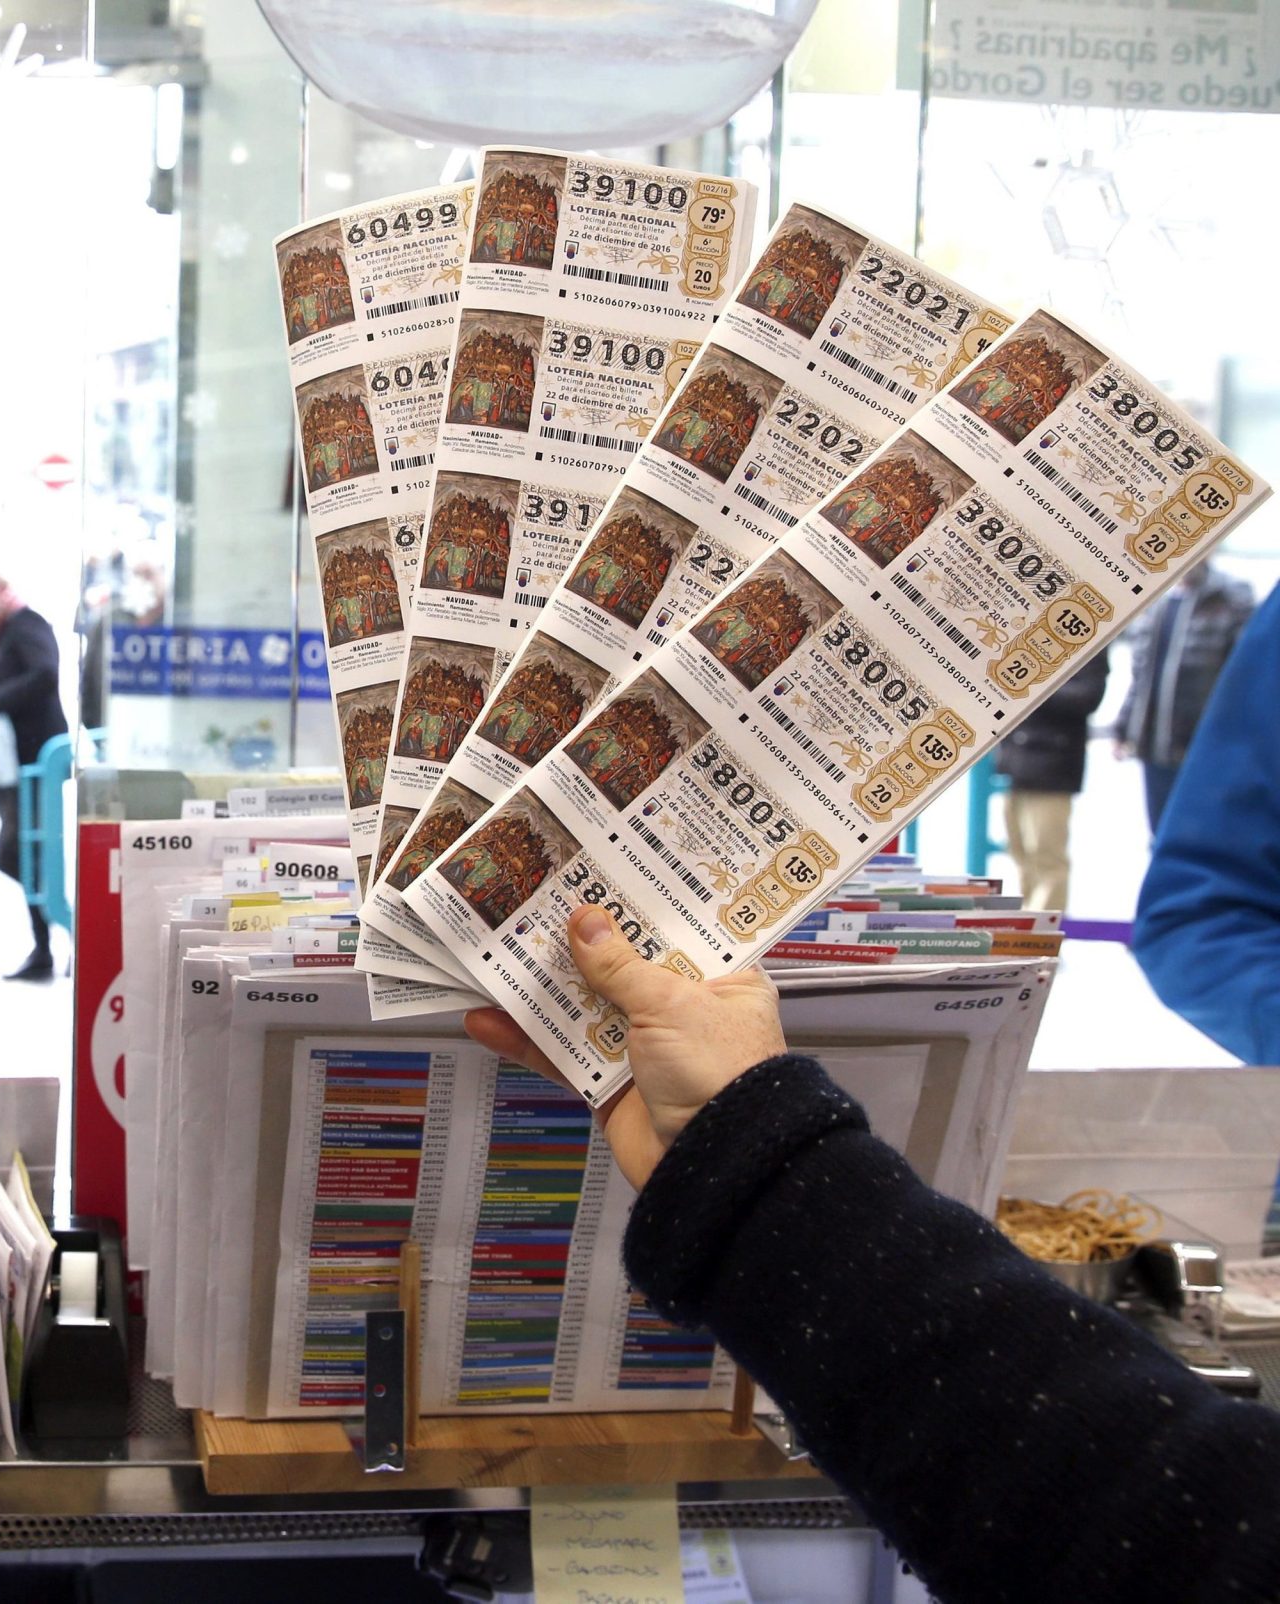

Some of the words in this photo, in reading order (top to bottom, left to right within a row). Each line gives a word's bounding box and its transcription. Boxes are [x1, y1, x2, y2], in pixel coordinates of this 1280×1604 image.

[572, 173, 686, 208] 39100
[348, 203, 456, 243] 60499
[620, 213, 676, 228] NACIONAL
[403, 234, 457, 249] NACIONAL
[569, 229, 579, 237] 22
[581, 232, 592, 240] de
[594, 234, 635, 247] diciembre
[637, 241, 648, 249] de
[650, 243, 670, 253] 2016
[361, 275, 370, 284] 22
[372, 273, 383, 281] de
[385, 265, 424, 277] diciembre
[439, 257, 459, 267] 2016
[694, 269, 711, 283] 20
[860, 258, 968, 329] 22021
[840, 309, 851, 319] 22
[851, 317, 862, 326] de
[863, 324, 900, 349] diciembre
[901, 347, 912, 356] de
[913, 352, 933, 367] 2016
[896, 313, 946, 346] NACIONAL
[987, 316, 1008, 331] 102/1
[549, 331, 664, 369] 39100
[371, 358, 449, 391] 604
[598, 374, 653, 389] NACIONAL
[546, 390, 556, 399] 22
[558, 393, 569, 401] de
[571, 395, 613, 409] diciembre
[615, 403, 626, 411] de
[628, 405, 648, 415] 2016
[776, 400, 862, 462] 2202
[1091, 376, 1201, 469] 38005
[755, 452, 766, 462] 22
[766, 460, 776, 469] de
[777, 467, 815, 493] diciembre
[1056, 422, 1068, 434] 22
[1067, 433, 1078, 443] de
[1078, 442, 1115, 475] diciembre
[1114, 475, 1125, 485] de
[1125, 483, 1146, 502] 2016
[1118, 439, 1167, 484] NACIONAL
[525, 495, 589, 525] 391
[958, 499, 1064, 595] 38005
[1144, 534, 1166, 553] 20
[689, 544, 743, 581] 22
[923, 546, 934, 557] 22
[933, 557, 944, 567] de
[943, 567, 978, 601] diciembre
[978, 600, 989, 611] de
[988, 609, 1008, 628] 2016
[982, 564, 1029, 610] NACIONAL
[825, 622, 927, 719] 38005
[1006, 660, 1028, 679] 20
[845, 688, 893, 735] NACIONAL
[693, 744, 793, 841] 38005
[870, 784, 891, 803] 20
[132, 835, 193, 850] 45160
[711, 810, 759, 856] NACIONAL
[275, 862, 339, 880] 90608
[205, 907, 216, 915] 31
[549, 889, 575, 917] LOTE
[736, 905, 756, 924] 20
[313, 939, 320, 948] 6
[192, 980, 219, 995] 92
[247, 991, 319, 1003] 64560
[935, 996, 1003, 1011] 64560
[604, 1024, 624, 1043] 20
